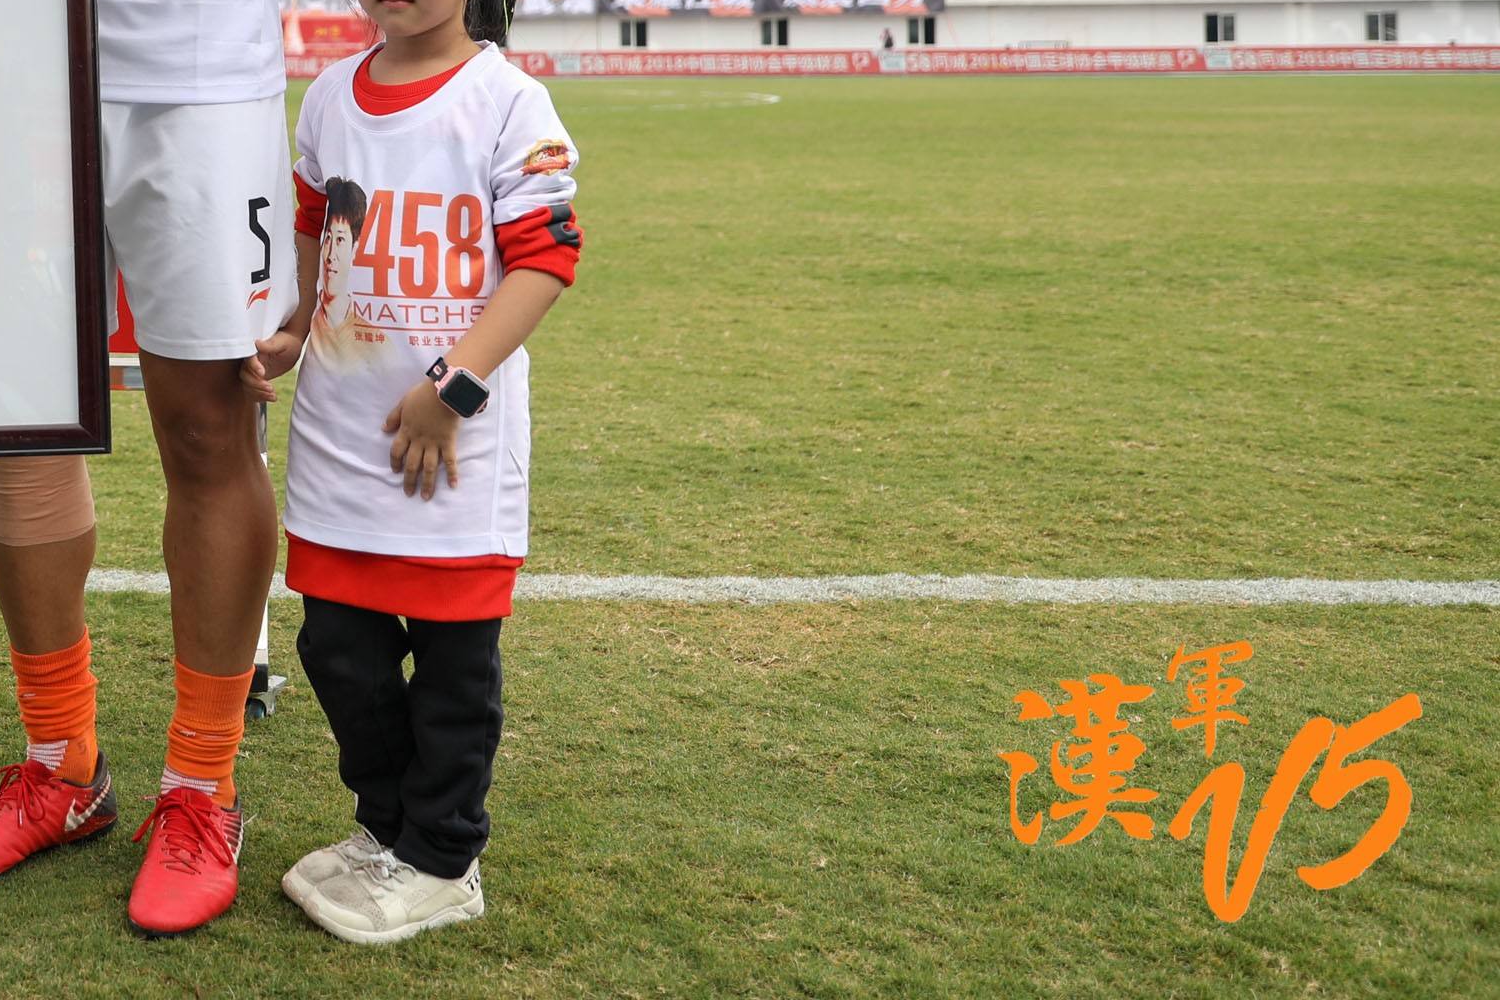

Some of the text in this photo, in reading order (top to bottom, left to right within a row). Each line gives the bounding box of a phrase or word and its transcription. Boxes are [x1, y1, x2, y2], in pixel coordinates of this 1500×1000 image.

[248, 196, 271, 284] 5
[352, 189, 485, 299] 458
[353, 301, 485, 325] MATCHS
